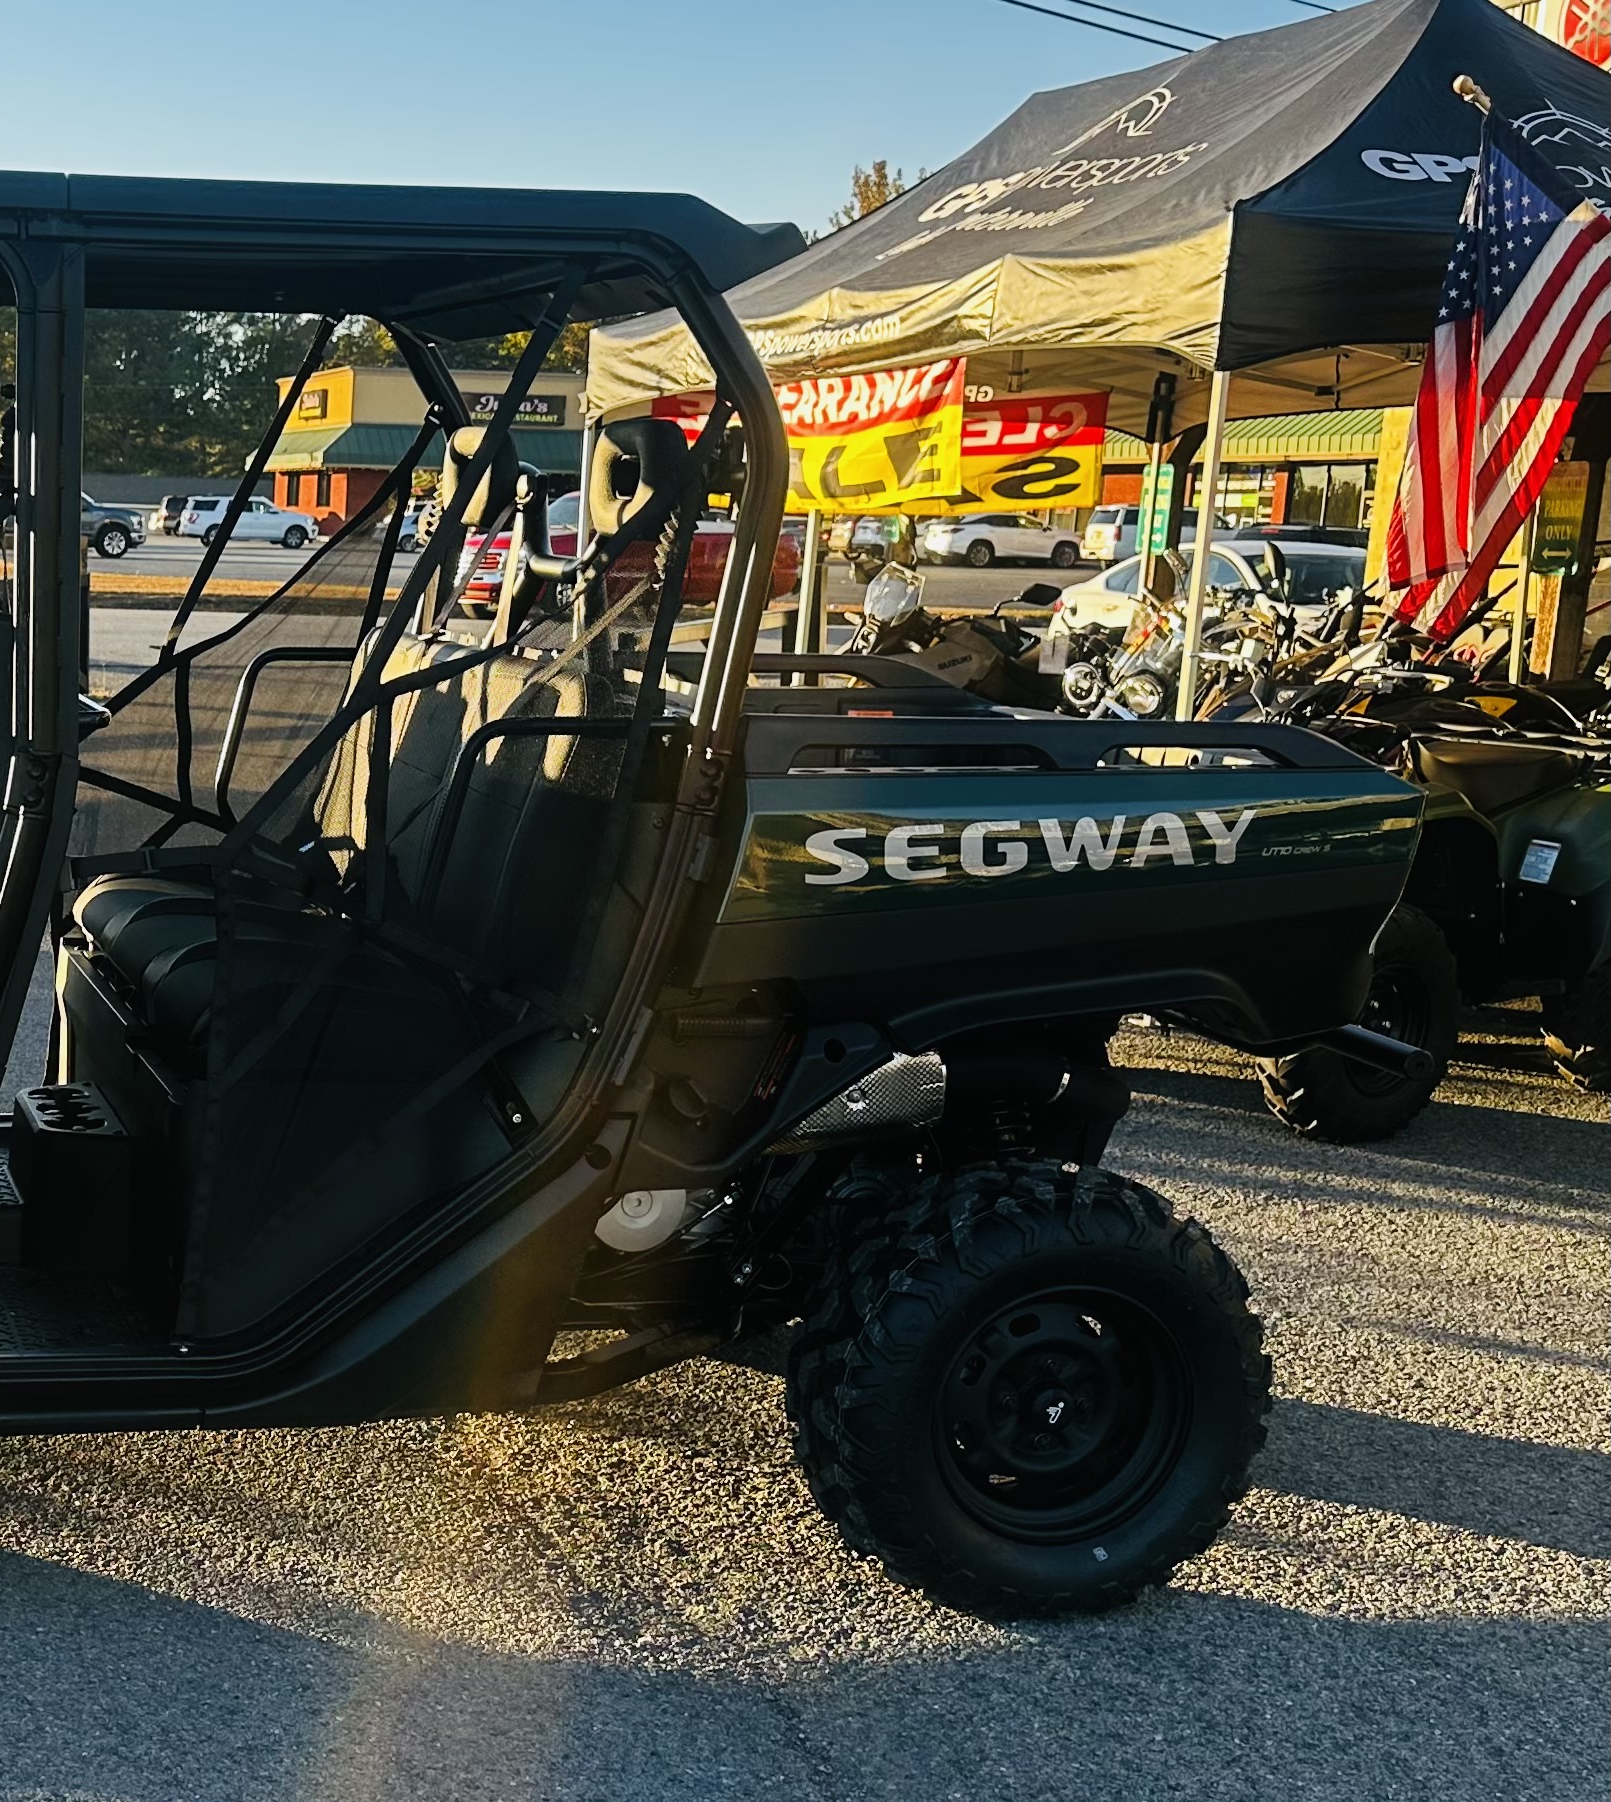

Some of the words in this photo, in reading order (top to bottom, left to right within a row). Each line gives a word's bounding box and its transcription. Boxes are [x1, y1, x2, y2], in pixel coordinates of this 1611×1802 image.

[1543, 499, 1582, 518] PARKING
[1545, 524, 1574, 540] ONLY
[937, 654, 973, 671] SUZUKI
[804, 808, 1258, 885] SEGWAY
